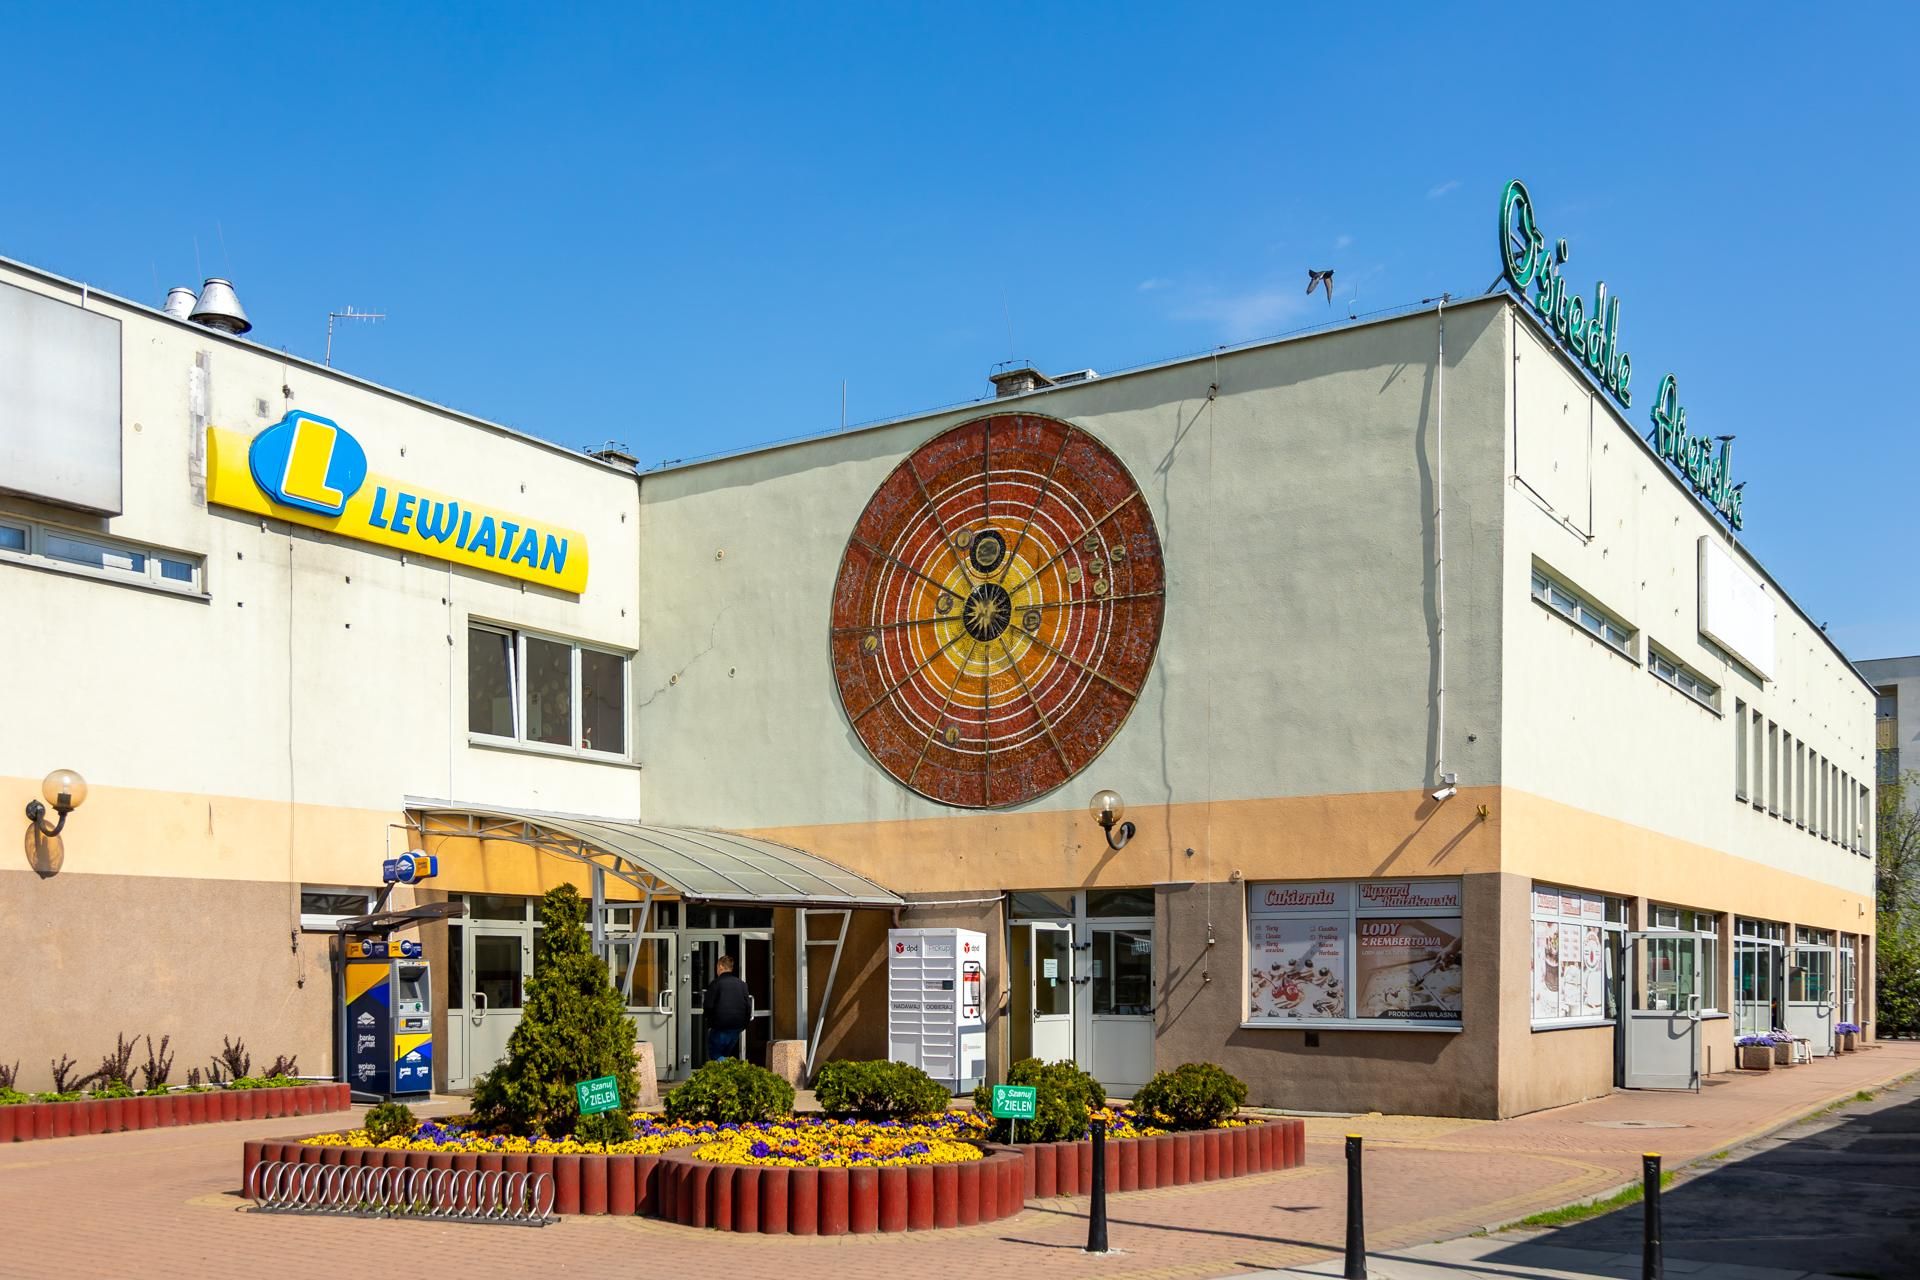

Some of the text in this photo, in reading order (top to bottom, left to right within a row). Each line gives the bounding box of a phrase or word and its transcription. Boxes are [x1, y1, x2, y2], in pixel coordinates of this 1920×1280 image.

[1498, 178, 1744, 532] Osiedle Ateńska
[368, 485, 569, 574] LEWIATAN
[1264, 888, 1335, 907] Cukiernia
[1382, 894, 1457, 908] Radzikowski
[1361, 923, 1400, 936] LODY
[1361, 936, 1441, 946] Z REMBERTOWA
[906, 944, 918, 953] dpd
[591, 1080, 613, 1091] Szanuj
[1007, 1089, 1033, 1100] Szanuj
